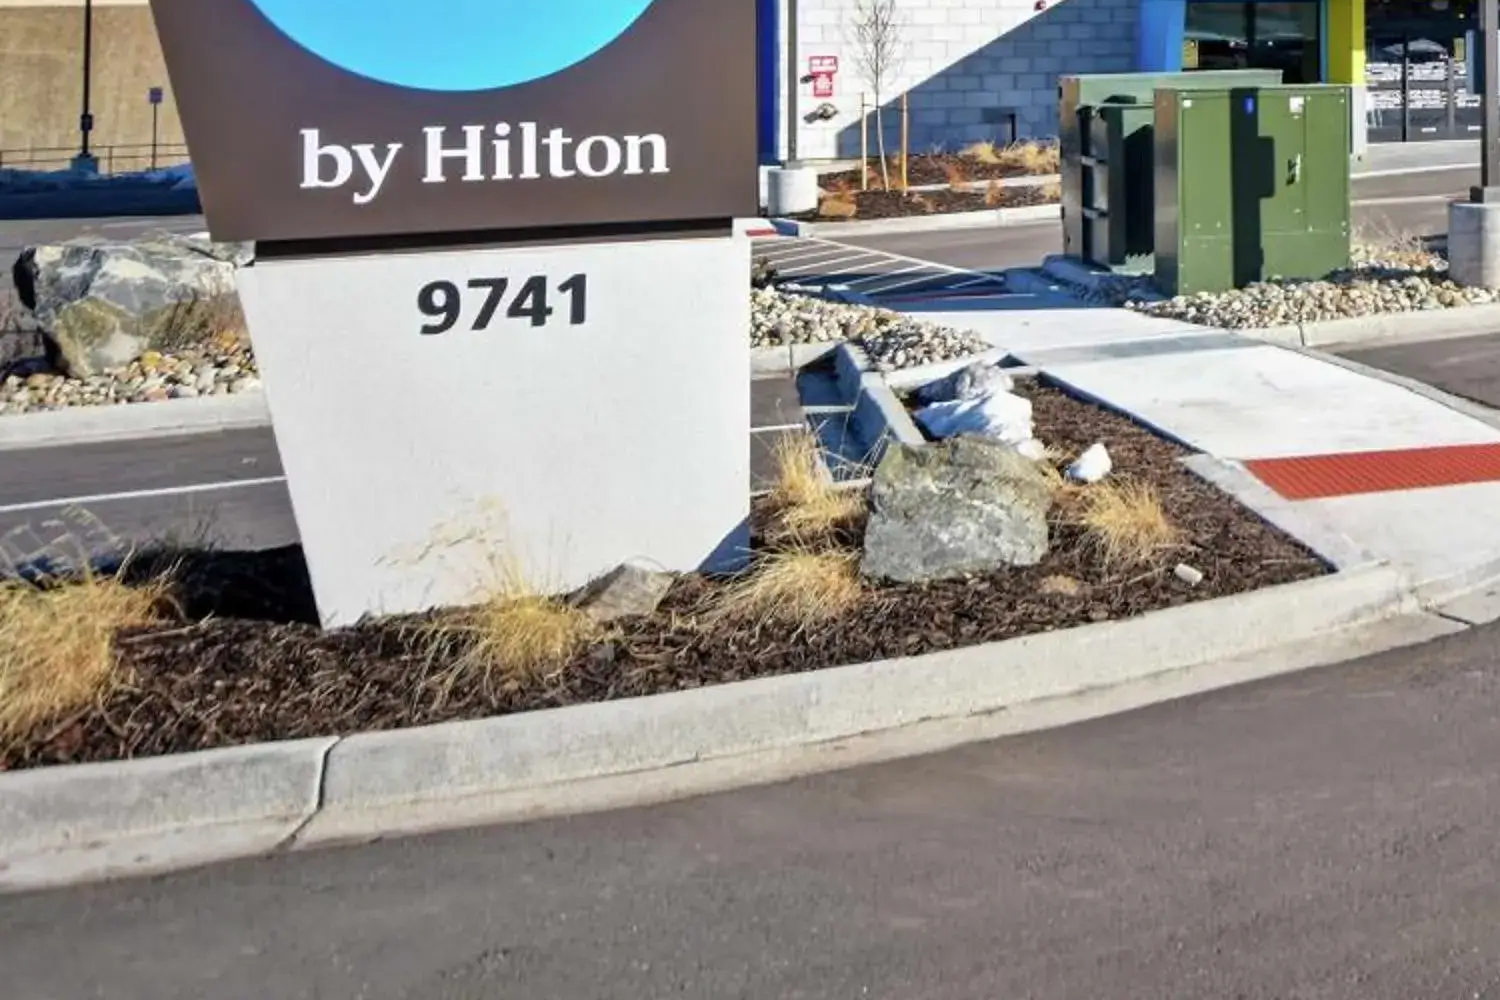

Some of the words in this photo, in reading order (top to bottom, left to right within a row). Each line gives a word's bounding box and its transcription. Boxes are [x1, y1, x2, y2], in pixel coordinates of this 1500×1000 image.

[300, 128, 402, 204] by
[422, 121, 670, 183] Hilton
[417, 273, 588, 335] 9741
